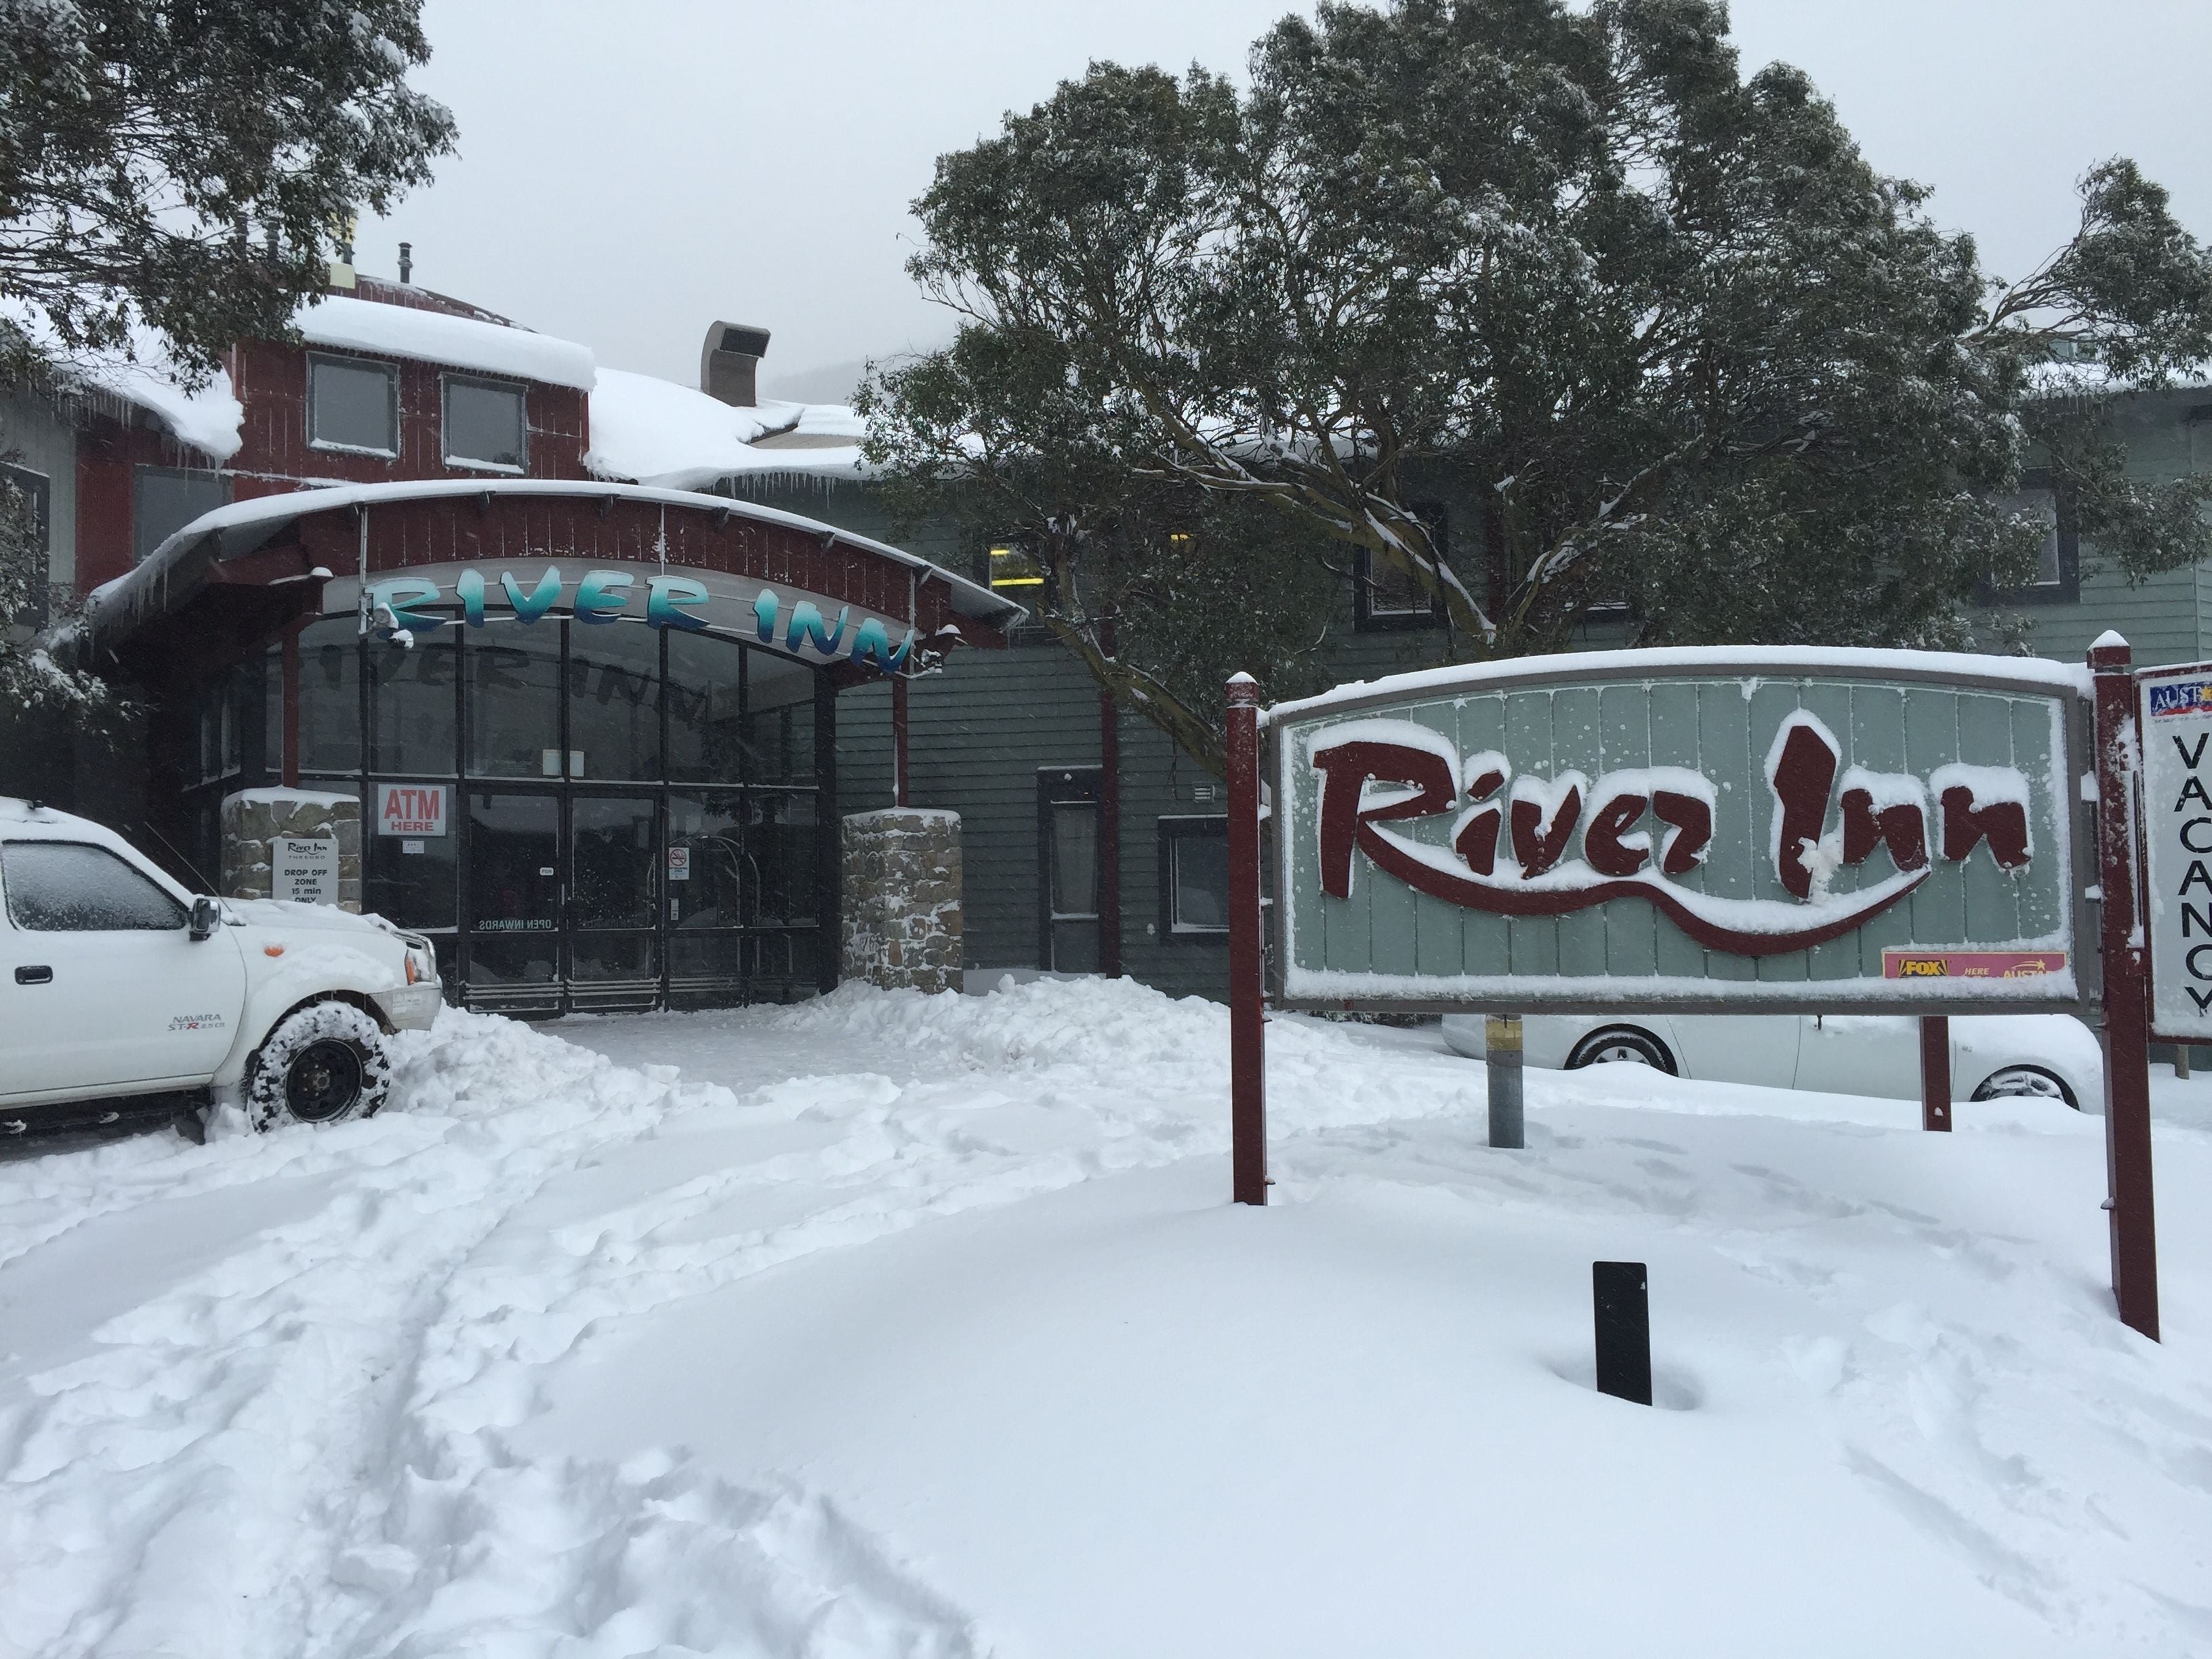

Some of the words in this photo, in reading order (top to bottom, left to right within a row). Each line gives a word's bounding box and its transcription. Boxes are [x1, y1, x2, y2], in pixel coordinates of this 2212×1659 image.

[365, 565, 710, 632] RIVER
[753, 587, 916, 674] INN
[384, 789, 439, 820] ATM
[391, 821, 434, 832] HERE
[1312, 740, 1713, 916] River
[1773, 724, 2031, 902] Inn
[287, 842, 311, 853] River
[314, 842, 327, 852] Inn
[2172, 733, 2212, 1017] VACANCY
[1906, 961, 1941, 976] FOX
[1965, 967, 1990, 976] HERE
[173, 1014, 222, 1023] NAVARA
[167, 1022, 199, 1031] ST-R
